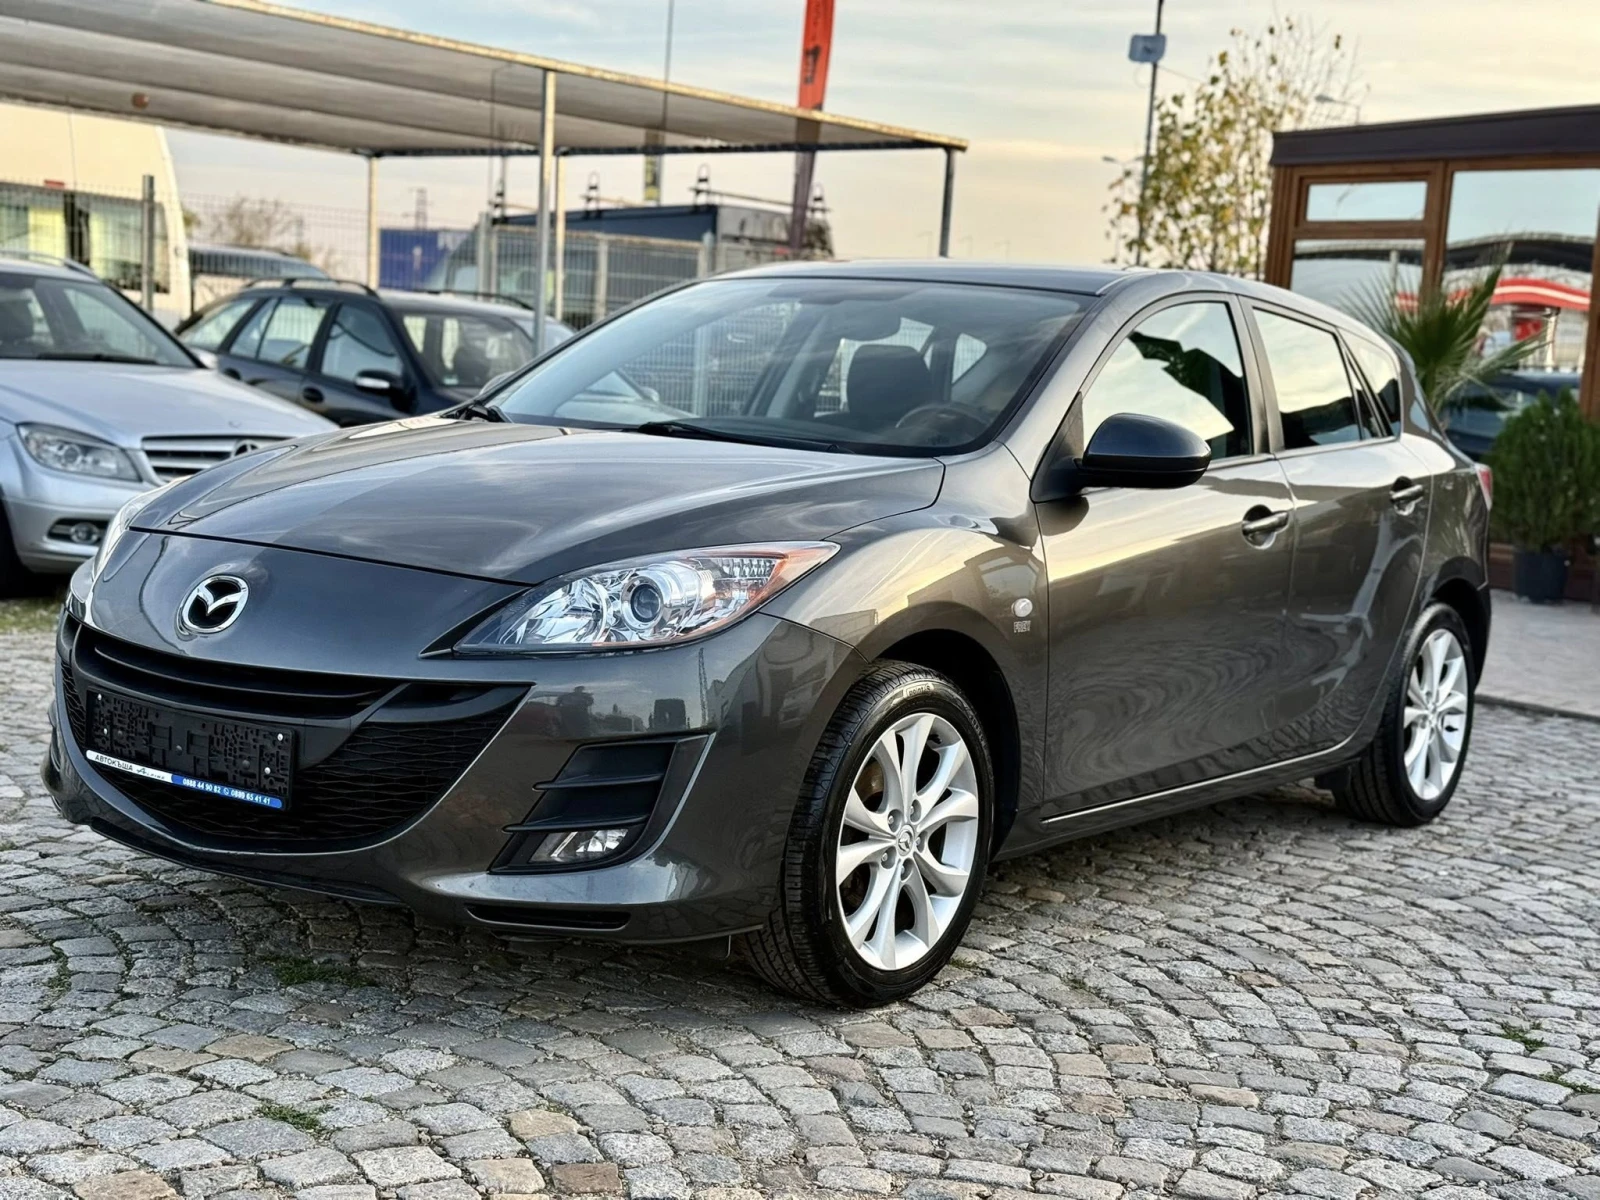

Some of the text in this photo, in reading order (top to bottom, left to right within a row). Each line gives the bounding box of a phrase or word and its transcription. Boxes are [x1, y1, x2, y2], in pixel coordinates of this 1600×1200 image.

[94, 754, 133, 771] АВТОКЪША
[197, 781, 205, 790] 44
[205, 783, 213, 792] 90
[213, 785, 221, 794] 82
[246, 793, 254, 801] 65
[254, 795, 262, 803] 41
[263, 797, 271, 805] 41
